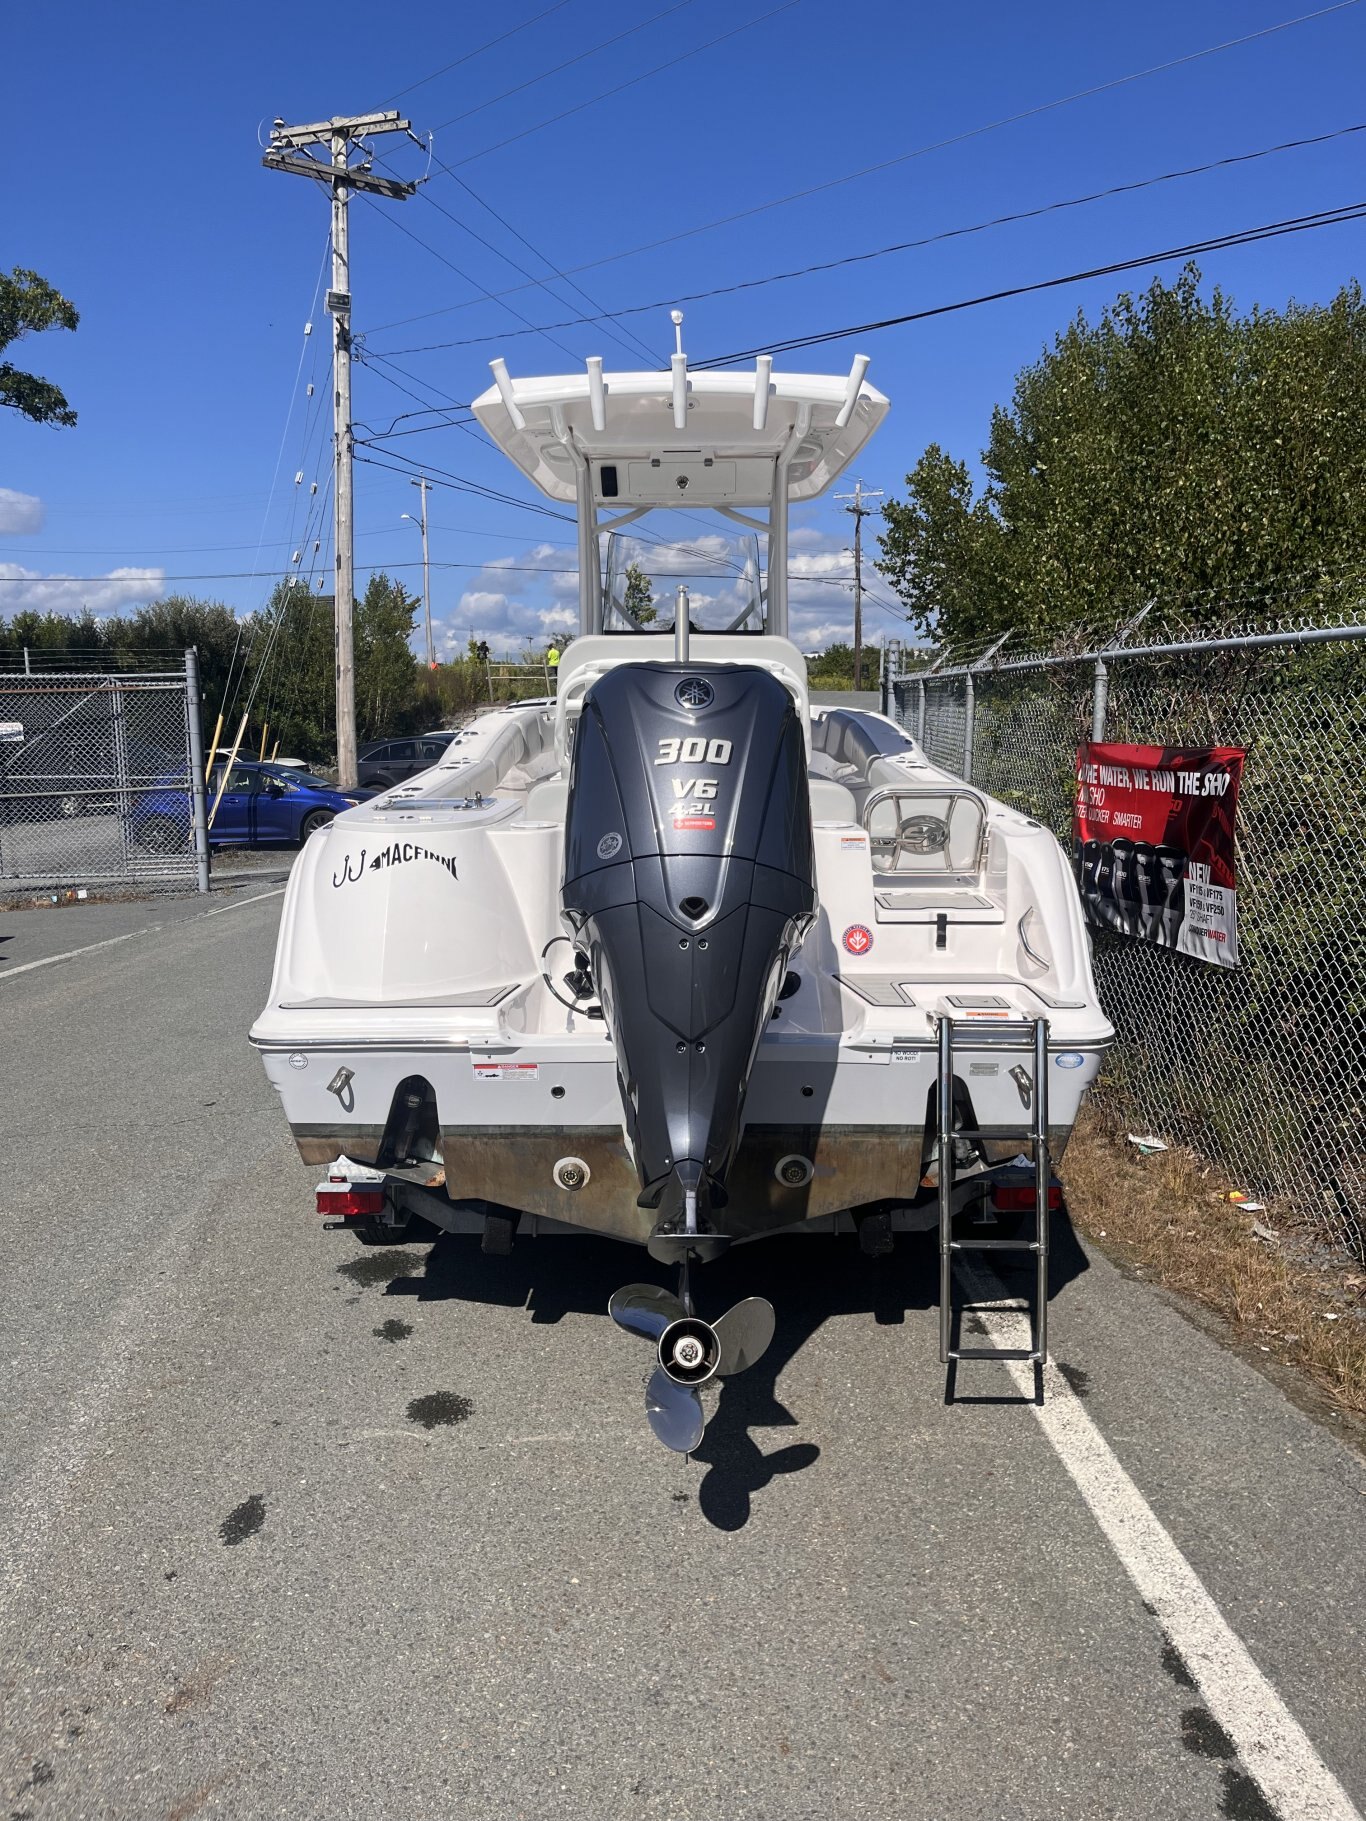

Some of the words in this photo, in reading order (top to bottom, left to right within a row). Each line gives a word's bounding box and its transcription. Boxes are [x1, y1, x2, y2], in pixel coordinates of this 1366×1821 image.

[654, 737, 733, 766] 300
[672, 778, 719, 800] V6
[1100, 765, 1132, 793] WATER,
[1132, 768, 1150, 791] WE
[1150, 770, 1175, 793] RUN
[1177, 771, 1201, 796] THE
[1089, 786, 1105, 807] SHO
[668, 803, 716, 816] 4.2L
[1112, 811, 1142, 830] SMARTER
[381, 843, 451, 872] MACFINN
[1188, 861, 1211, 885] NEW
